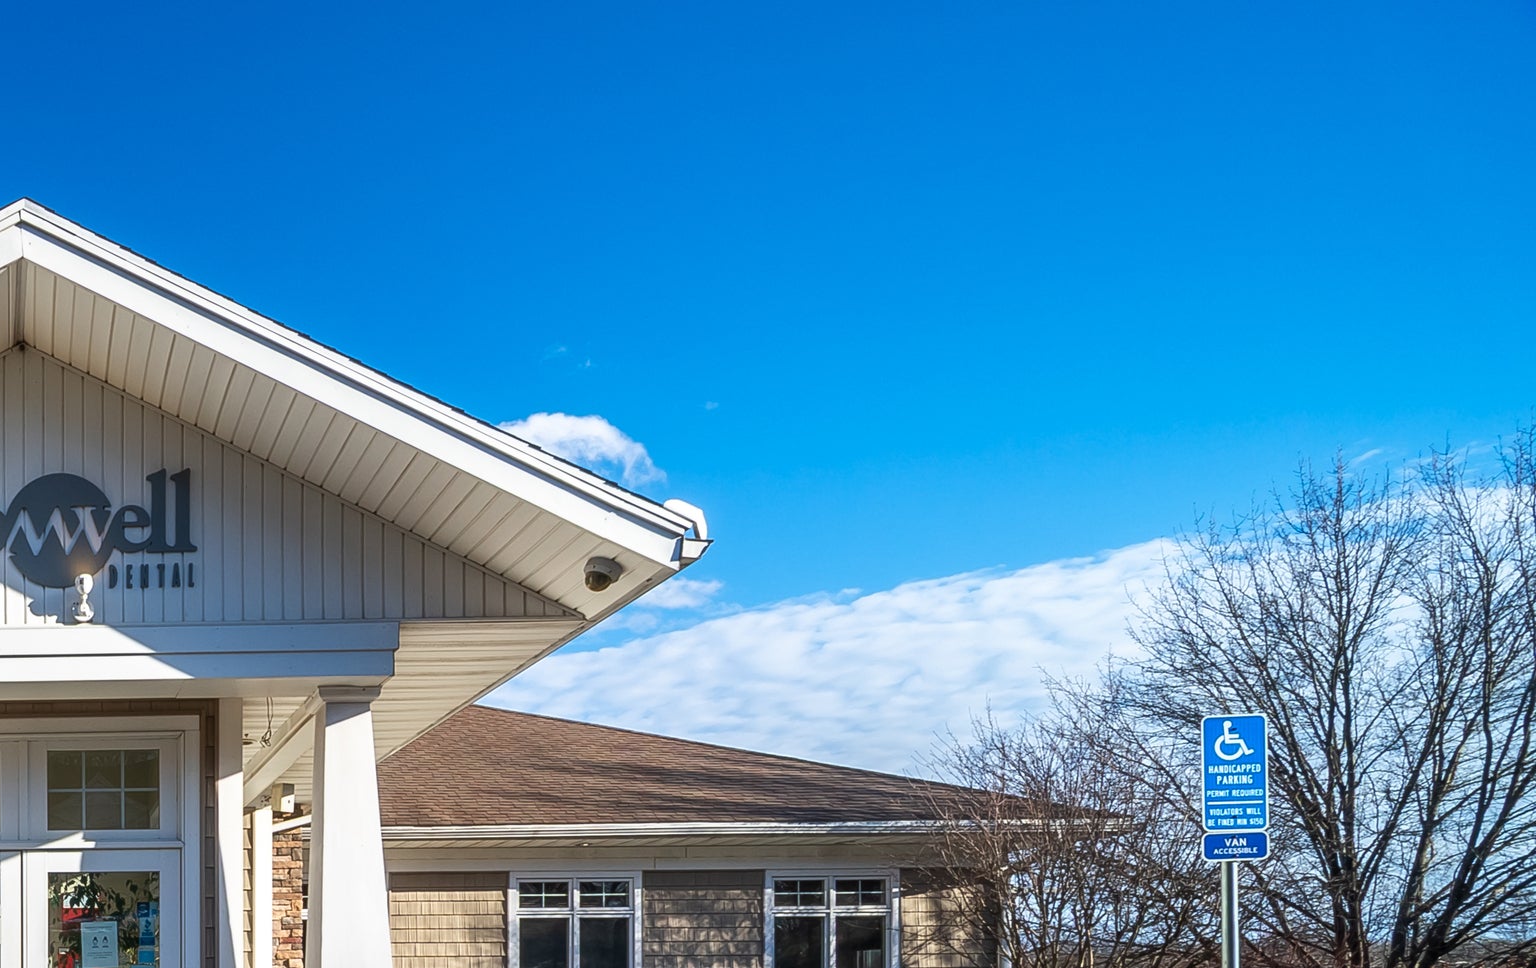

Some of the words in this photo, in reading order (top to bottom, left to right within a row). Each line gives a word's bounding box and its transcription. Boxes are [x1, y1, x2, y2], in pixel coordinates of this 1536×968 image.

[108, 562, 195, 589] DENTAL
[1208, 764, 1261, 774] HANDICAPPED
[1216, 775, 1253, 785] PARKING
[1209, 808, 1243, 816] VIOLATORS
[1217, 818, 1235, 826] FINED
[1224, 838, 1247, 847] VAN
[1213, 847, 1258, 855] ACCESSIBLE
